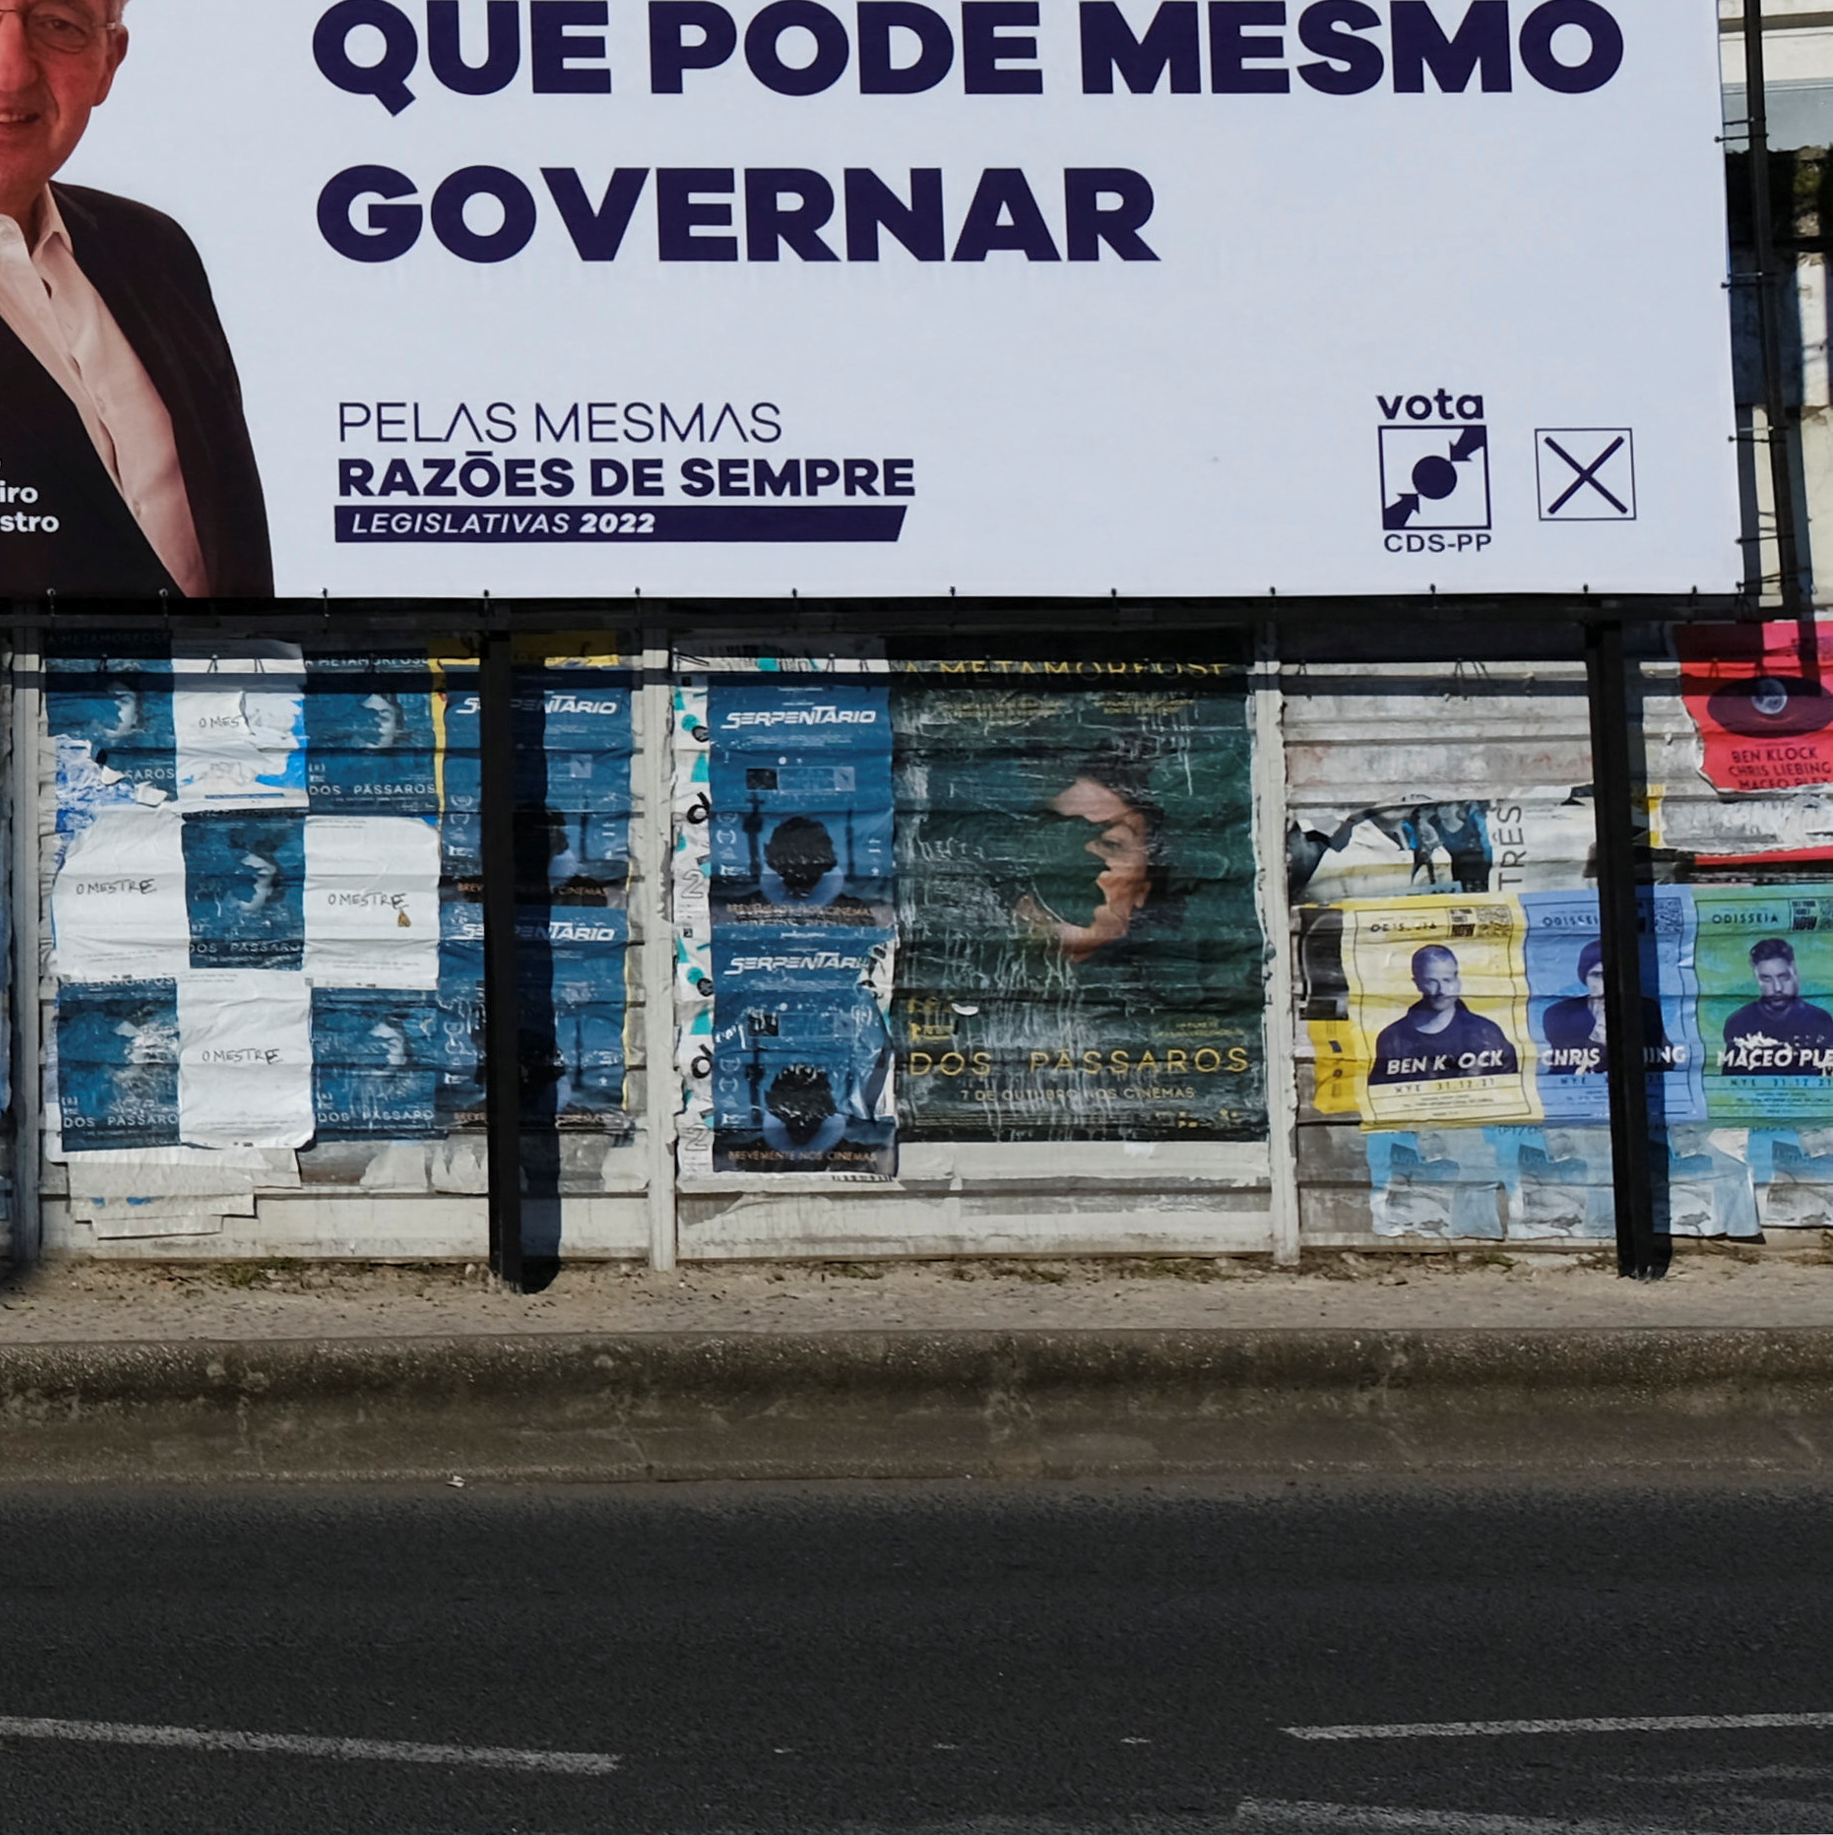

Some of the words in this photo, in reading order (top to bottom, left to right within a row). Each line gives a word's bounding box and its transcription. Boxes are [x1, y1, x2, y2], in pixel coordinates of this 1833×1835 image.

[316, 164, 1160, 264] GOVERNAR
[1376, 388, 1484, 420] vota
[339, 402, 517, 443] PELAS
[536, 402, 782, 443] MESMAS
[591, 458, 664, 496] DE
[680, 457, 915, 497] SEMPRE
[352, 512, 571, 535] LEGISLATIVAS
[579, 512, 656, 534] 2022
[1384, 533, 1492, 553] CDS-PP
[1732, 750, 1760, 763] BEN
[1767, 747, 1817, 761] KLOCK
[1728, 766, 1770, 777] CHRIS
[1775, 762, 1831, 776] LIEBING
[309, 785, 340, 795] DOS
[1712, 914, 1778, 924] ODISSEIA
[910, 1052, 992, 1076] DOS
[1387, 1056, 1426, 1075] BEN
[1542, 1048, 1600, 1066] CHRIS
[1717, 1048, 1792, 1067] MACEO
[975, 1090, 995, 1101] DE
[63, 1117, 95, 1128] DOS
